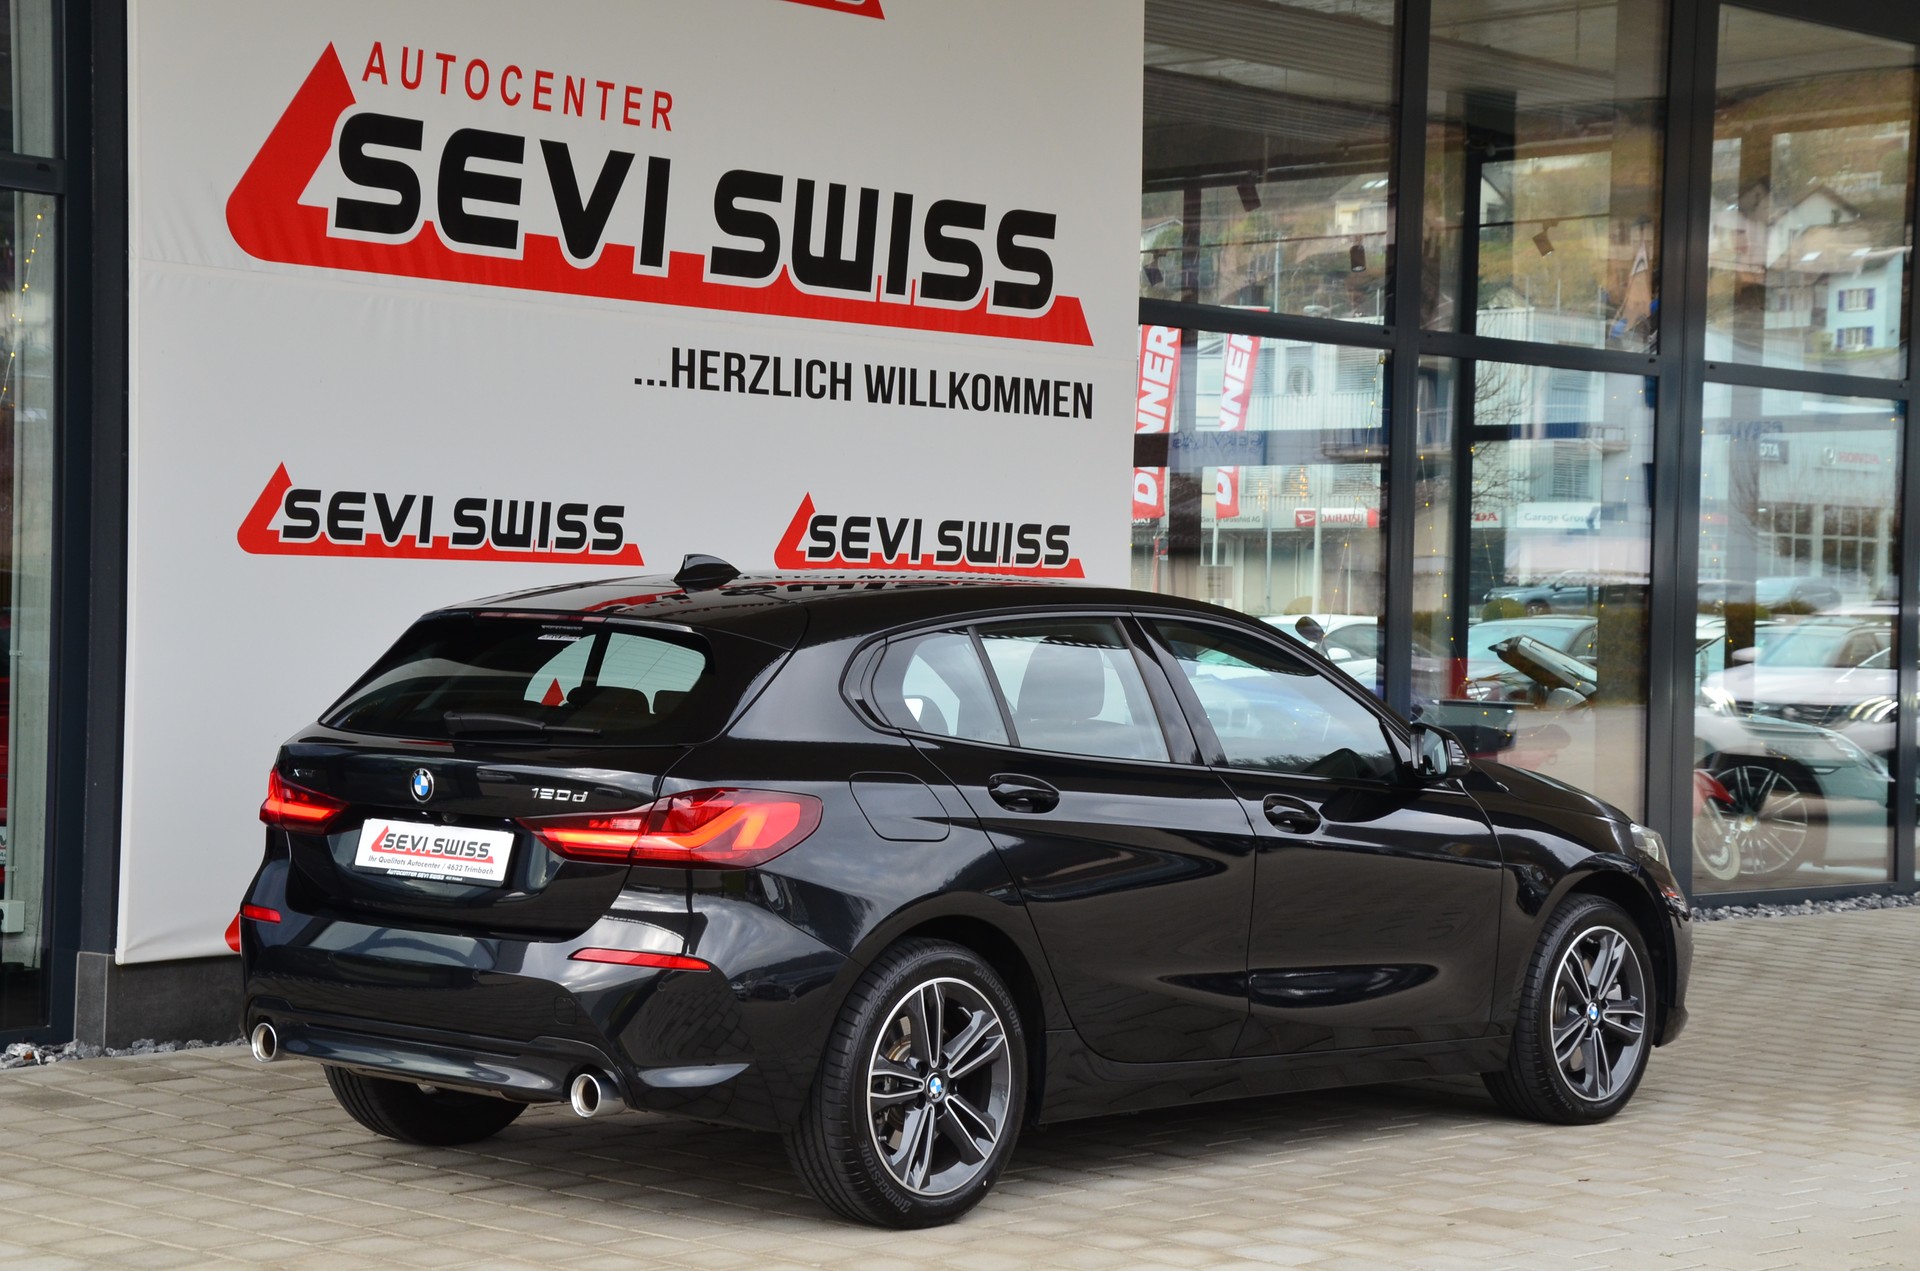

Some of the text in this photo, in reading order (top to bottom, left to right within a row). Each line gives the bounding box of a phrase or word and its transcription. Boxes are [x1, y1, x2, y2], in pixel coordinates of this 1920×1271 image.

[361, 41, 674, 132] AUTOCENTER
[334, 112, 1057, 310] SEVI SWISS
[865, 364, 1094, 420] WILLKOMMEN
[282, 488, 625, 551] SEVI SWISS
[807, 514, 1071, 565] SEVI SWISS
[1321, 513, 1364, 523] DAIHATSU
[1524, 513, 1558, 524] Garage
[531, 787, 589, 803] 120d
[368, 855, 378, 863] Ihr
[407, 860, 440, 869] Autocenter
[447, 864, 463, 872] 4632
[464, 866, 494, 875] Trimbach
[383, 833, 491, 859] SEVI SWISS
[858, 1139, 913, 1214] BRIDGESTONE
